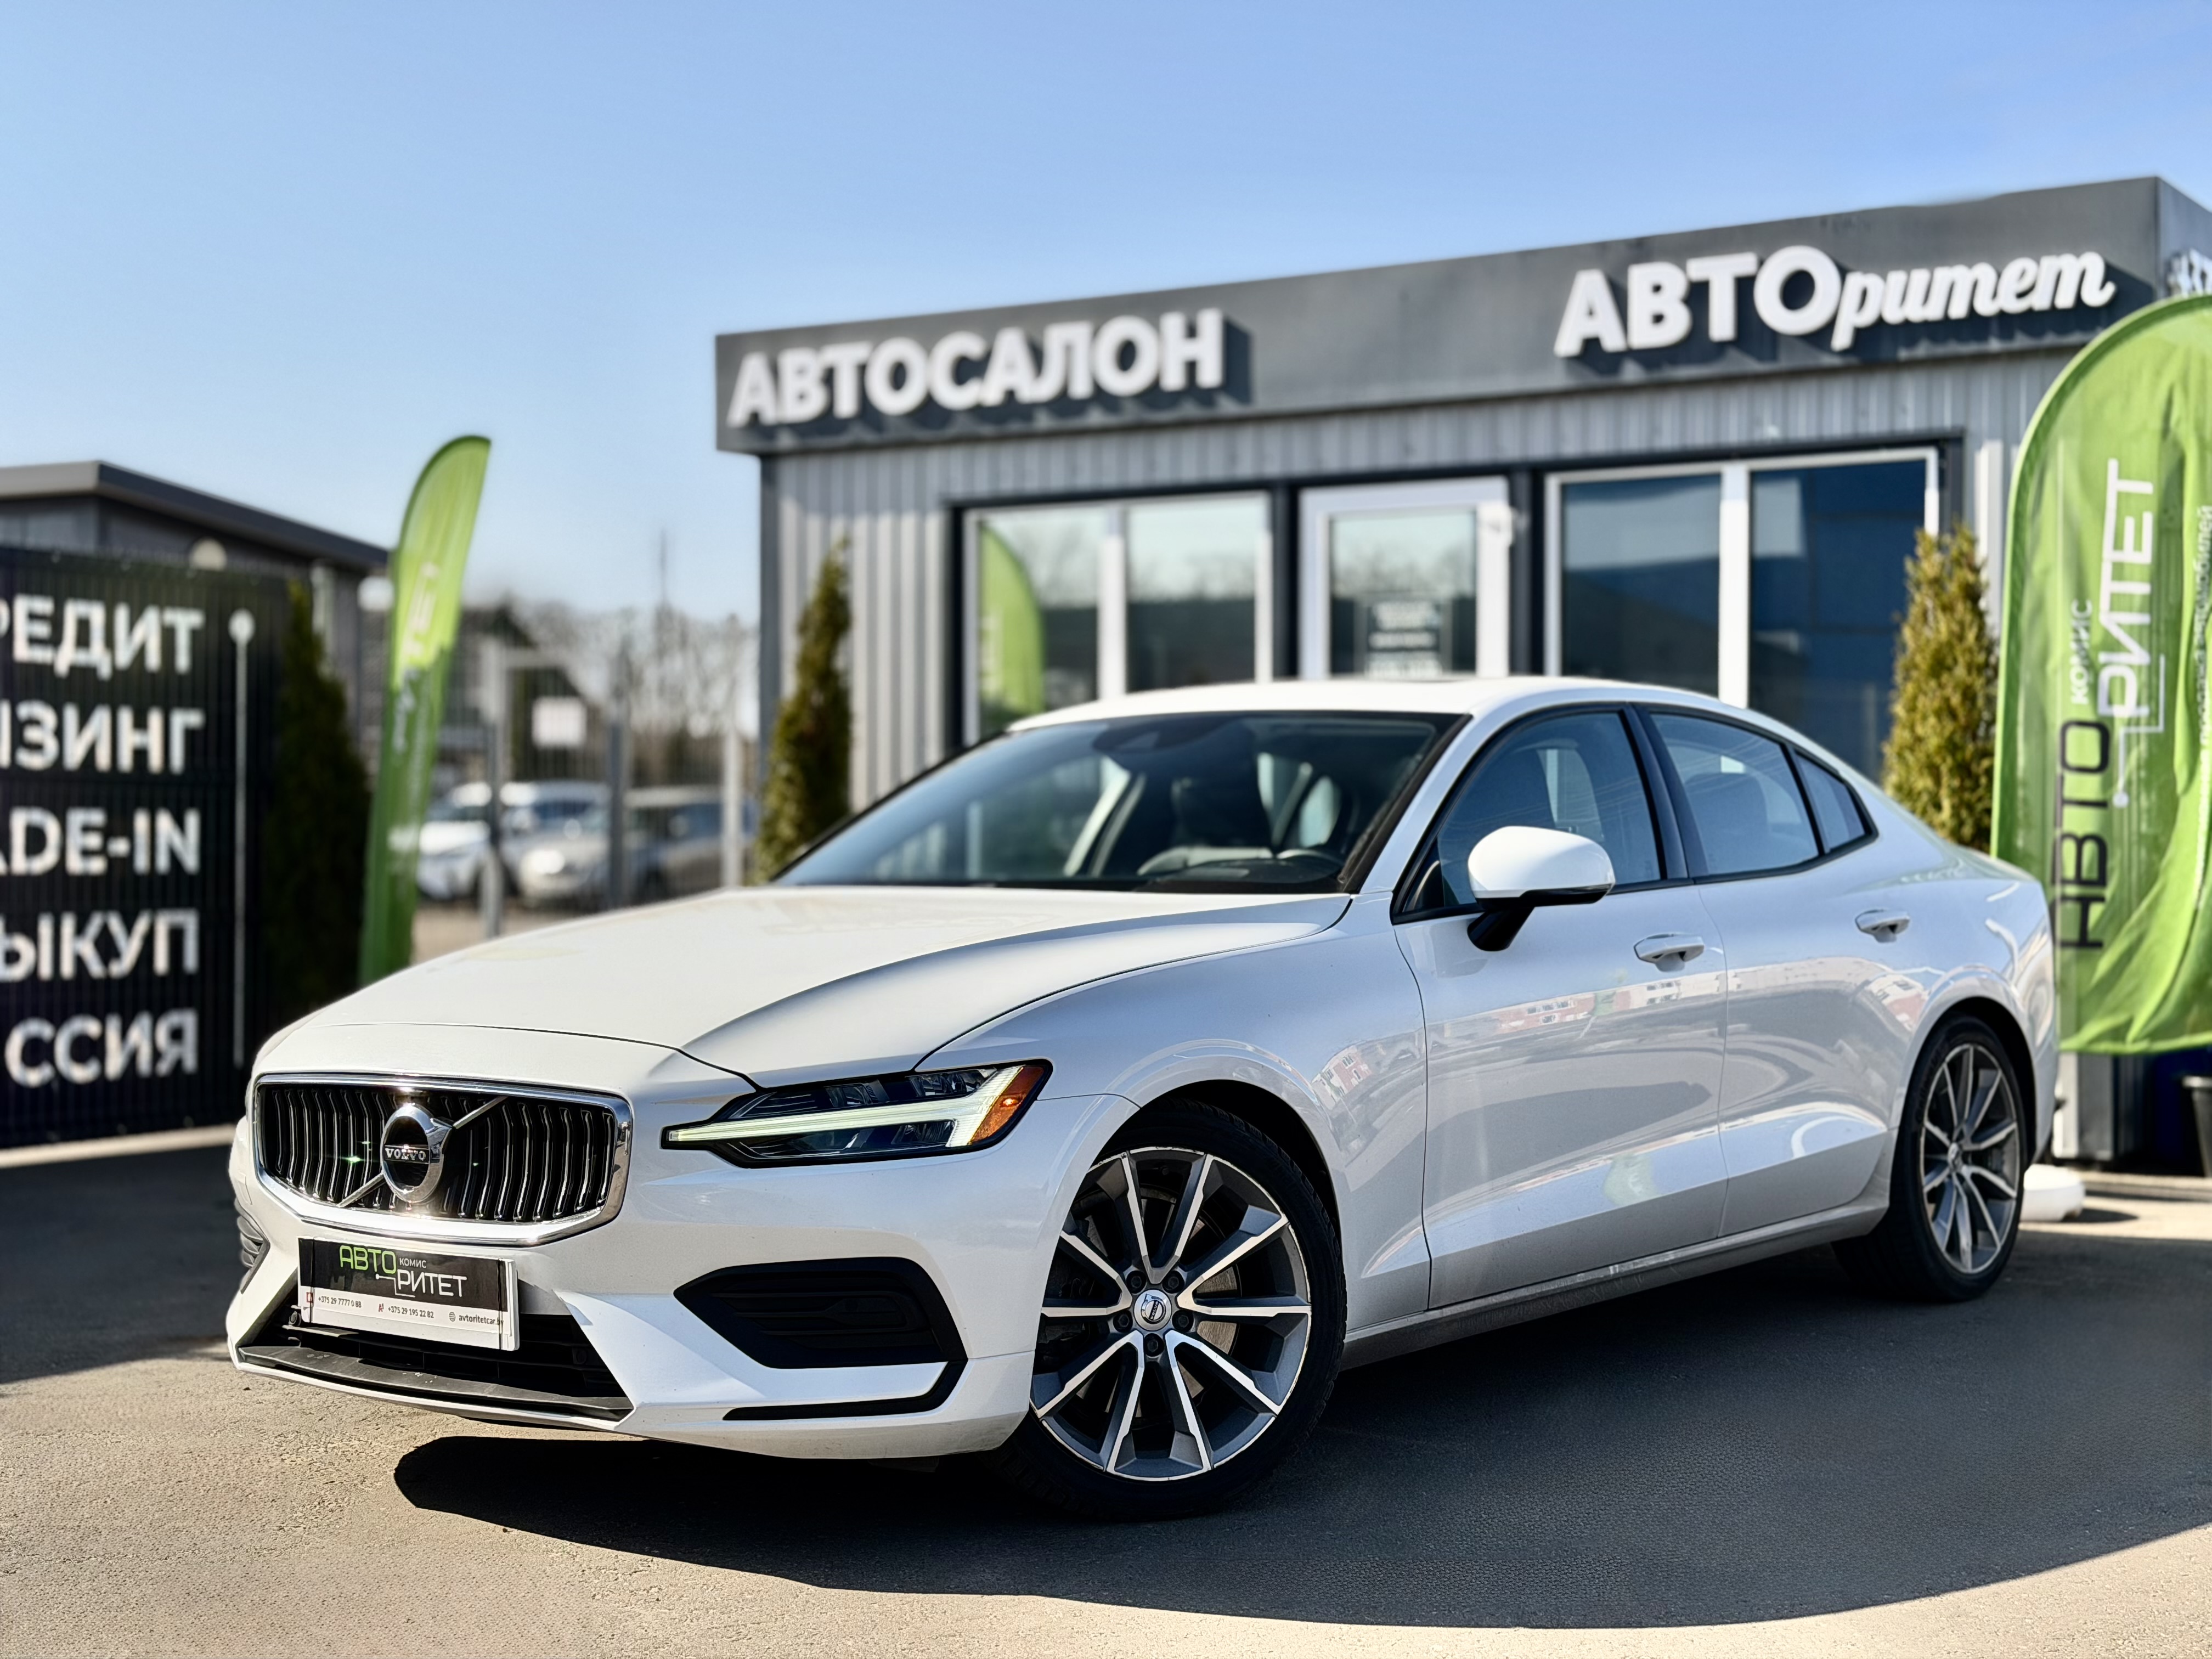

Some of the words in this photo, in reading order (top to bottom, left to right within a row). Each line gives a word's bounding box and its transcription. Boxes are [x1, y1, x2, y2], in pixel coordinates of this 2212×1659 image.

[1554, 245, 2116, 356] АВТОритет
[726, 308, 1223, 428] АВТОСАЛОН
[2096, 458, 2154, 718] РИТЕТ
[0, 593, 205, 681] ЕДИТ
[0, 700, 205, 774] ЗИНГ
[0, 807, 201, 875] DE-IN
[2049, 719, 2109, 950] АВТО
[4, 1009, 199, 1088] ССИЯ
[385, 1148, 426, 1161] VOLVO
[340, 1245, 396, 1274] АВТО
[397, 1269, 467, 1297] РИТЕТ
[399, 1257, 426, 1268] КОМИС
[338, 1298, 350, 1306] 7777
[388, 1306, 400, 1314] +375
[459, 1314, 504, 1325] avtoritetcar.by
